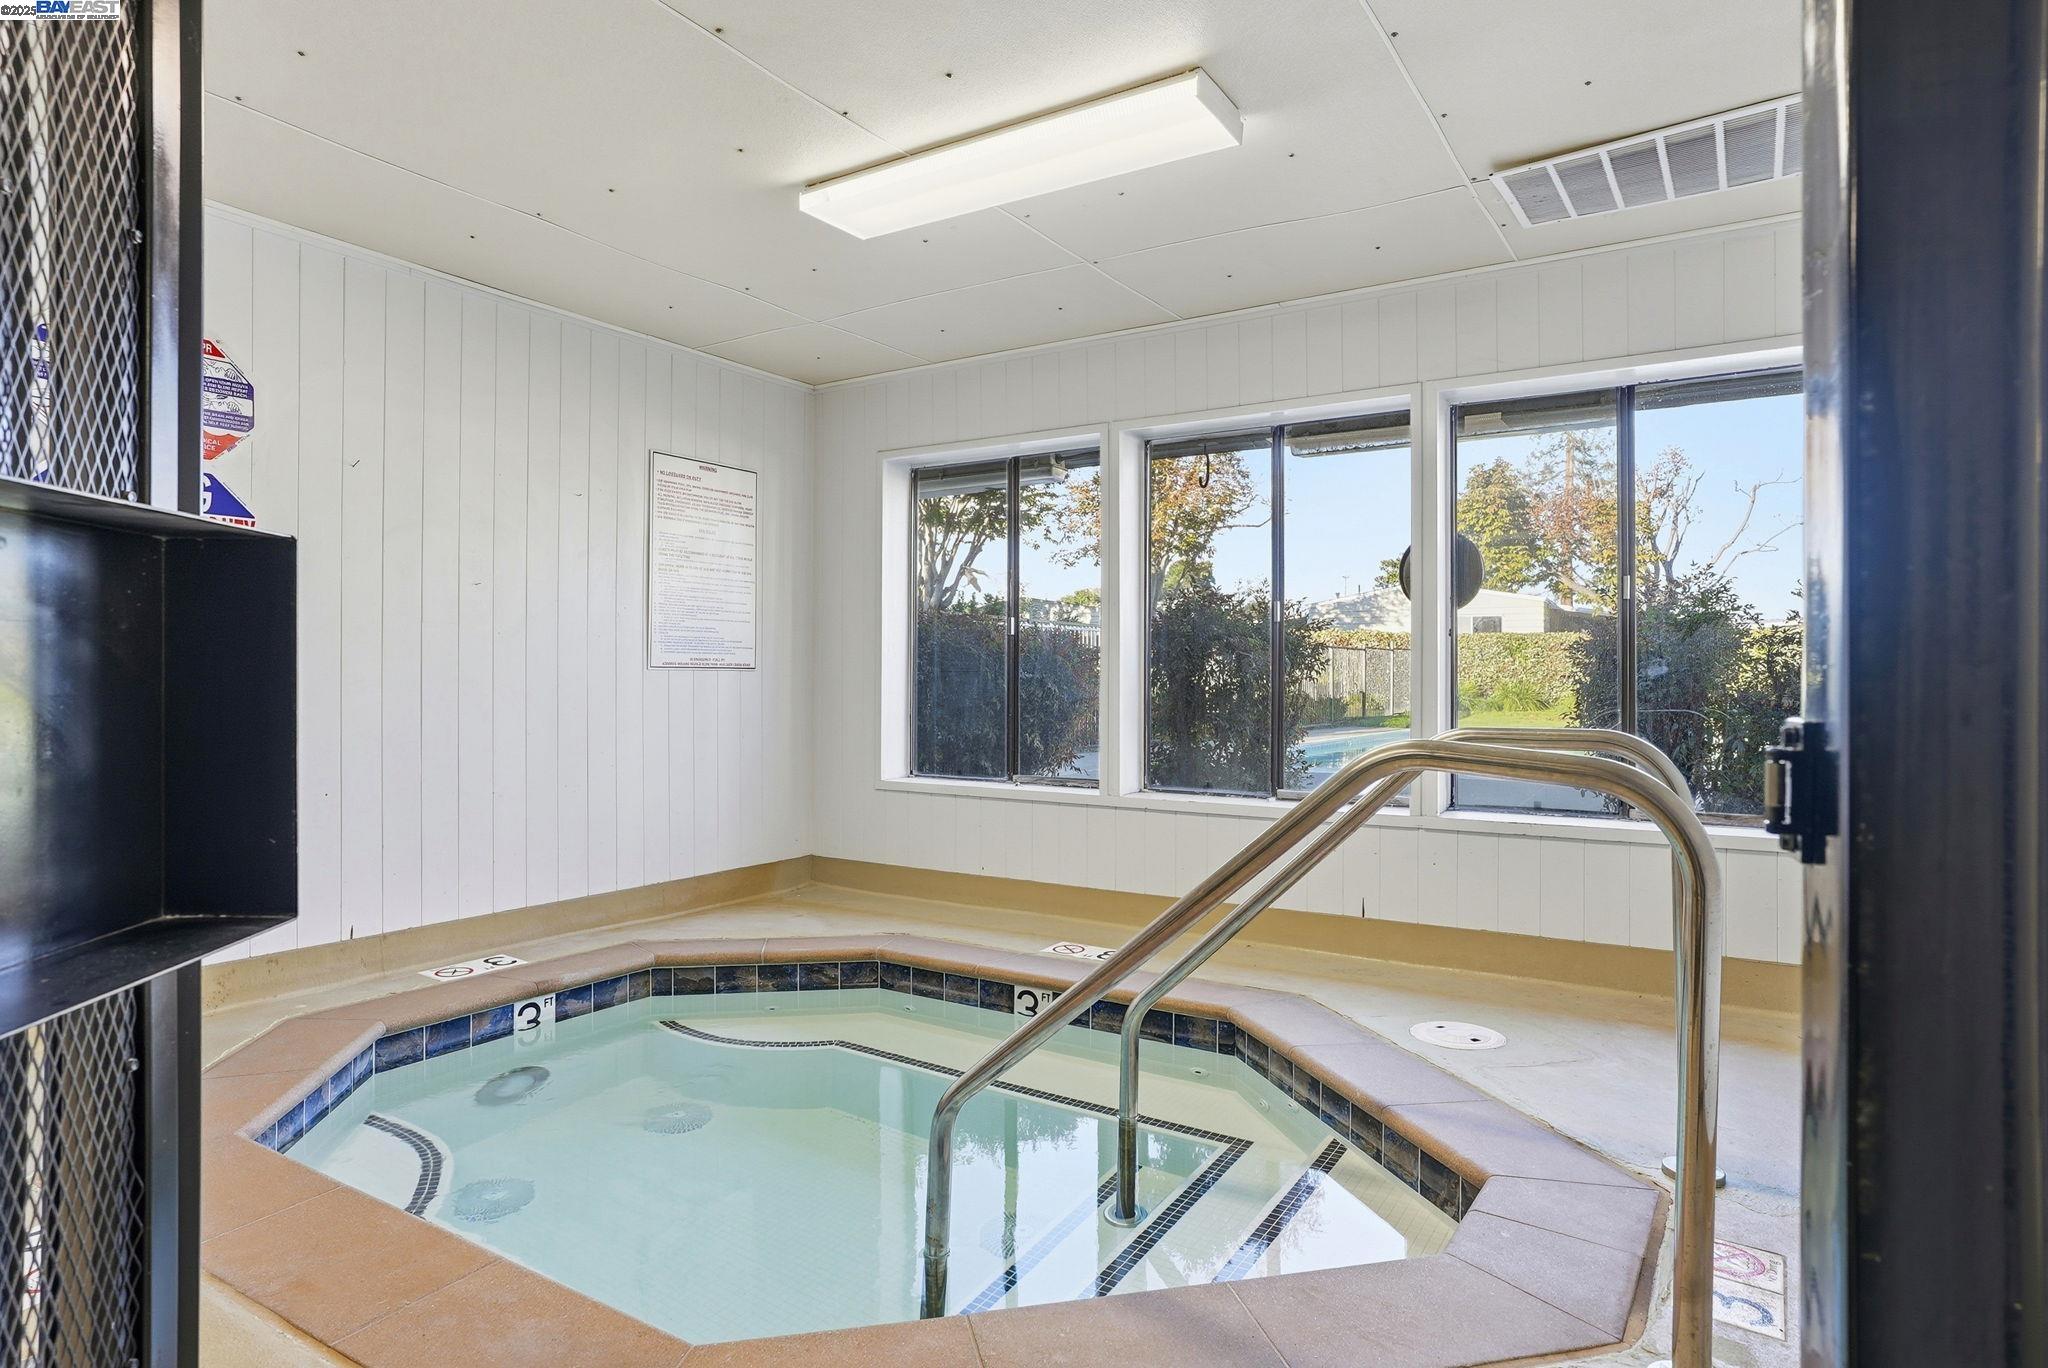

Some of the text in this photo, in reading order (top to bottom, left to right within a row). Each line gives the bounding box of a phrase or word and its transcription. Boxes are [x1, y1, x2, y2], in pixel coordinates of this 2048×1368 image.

[518, 997, 553, 1031] 3 FT
[1017, 990, 1051, 1017] 3 FT
